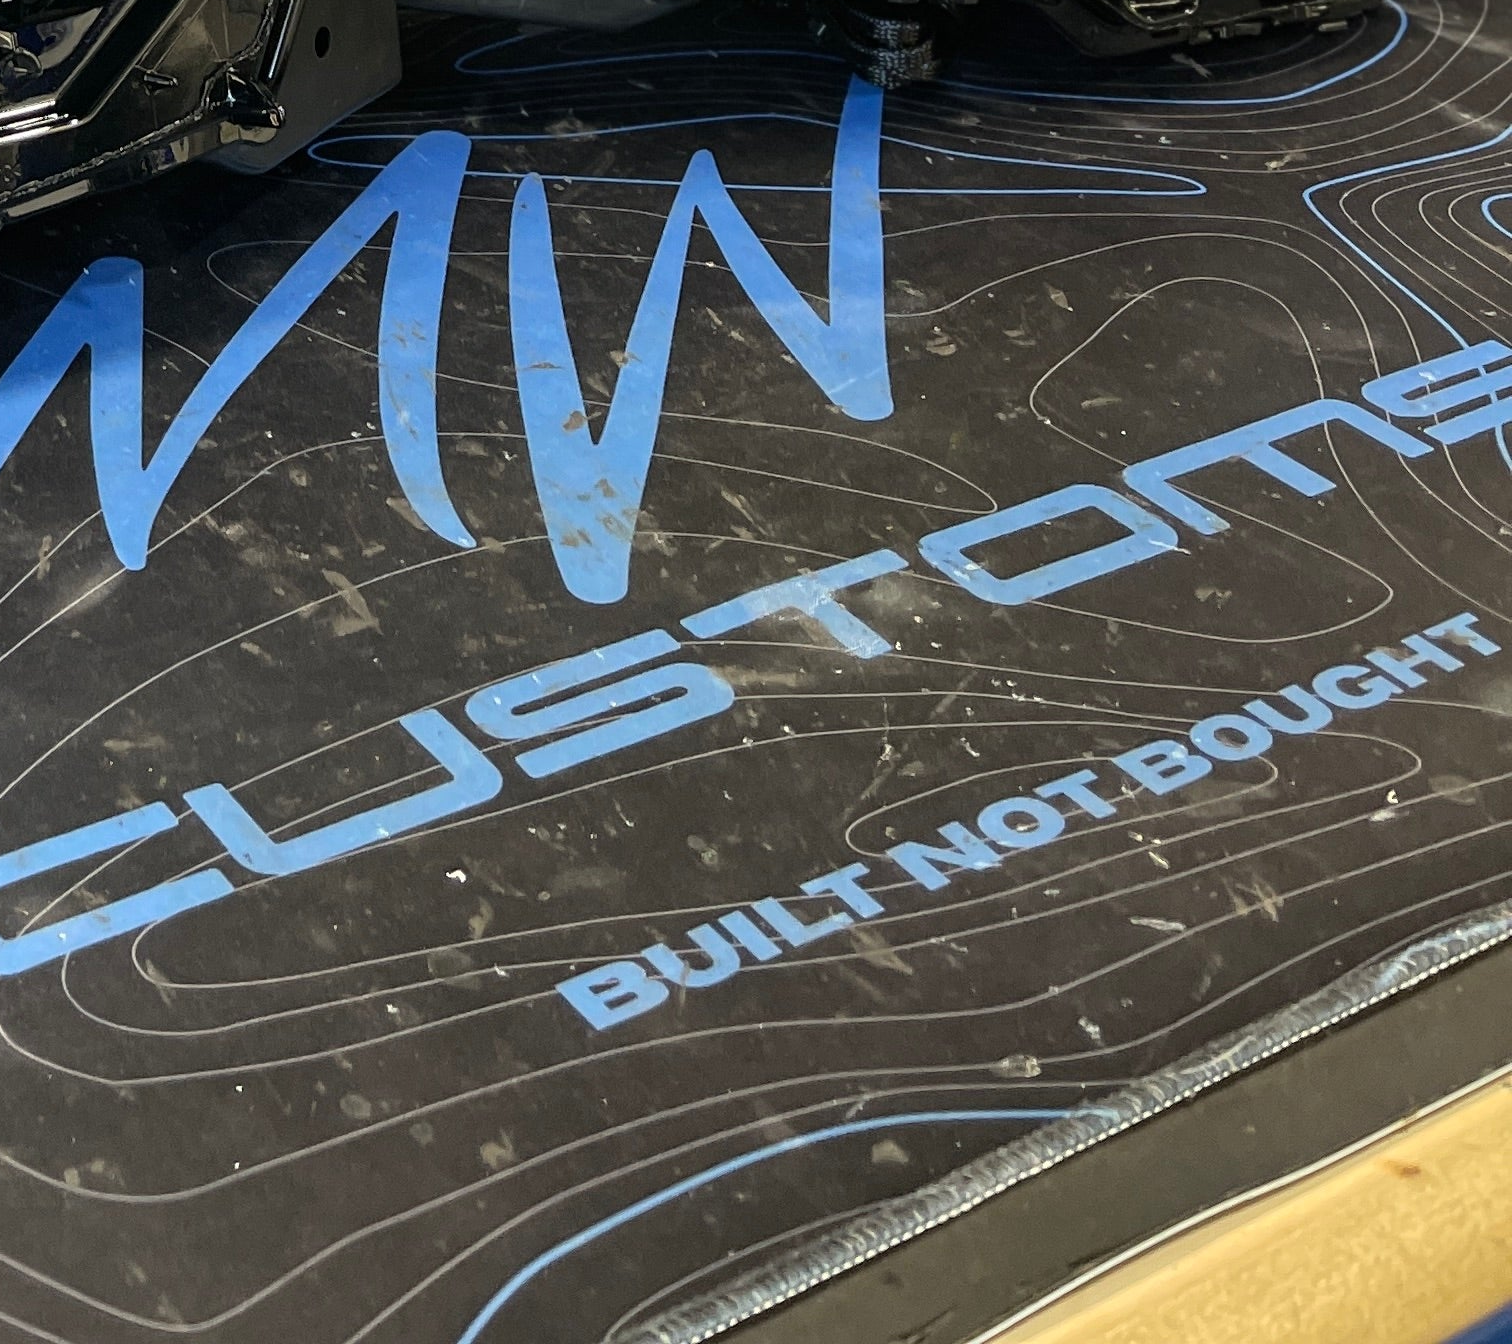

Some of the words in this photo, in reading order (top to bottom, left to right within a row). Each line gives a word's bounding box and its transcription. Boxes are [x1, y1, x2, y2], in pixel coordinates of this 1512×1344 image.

[553, 860, 886, 1032] BUILT
[884, 769, 1125, 891] NOT
[1125, 610, 1504, 797] BOUGHT
